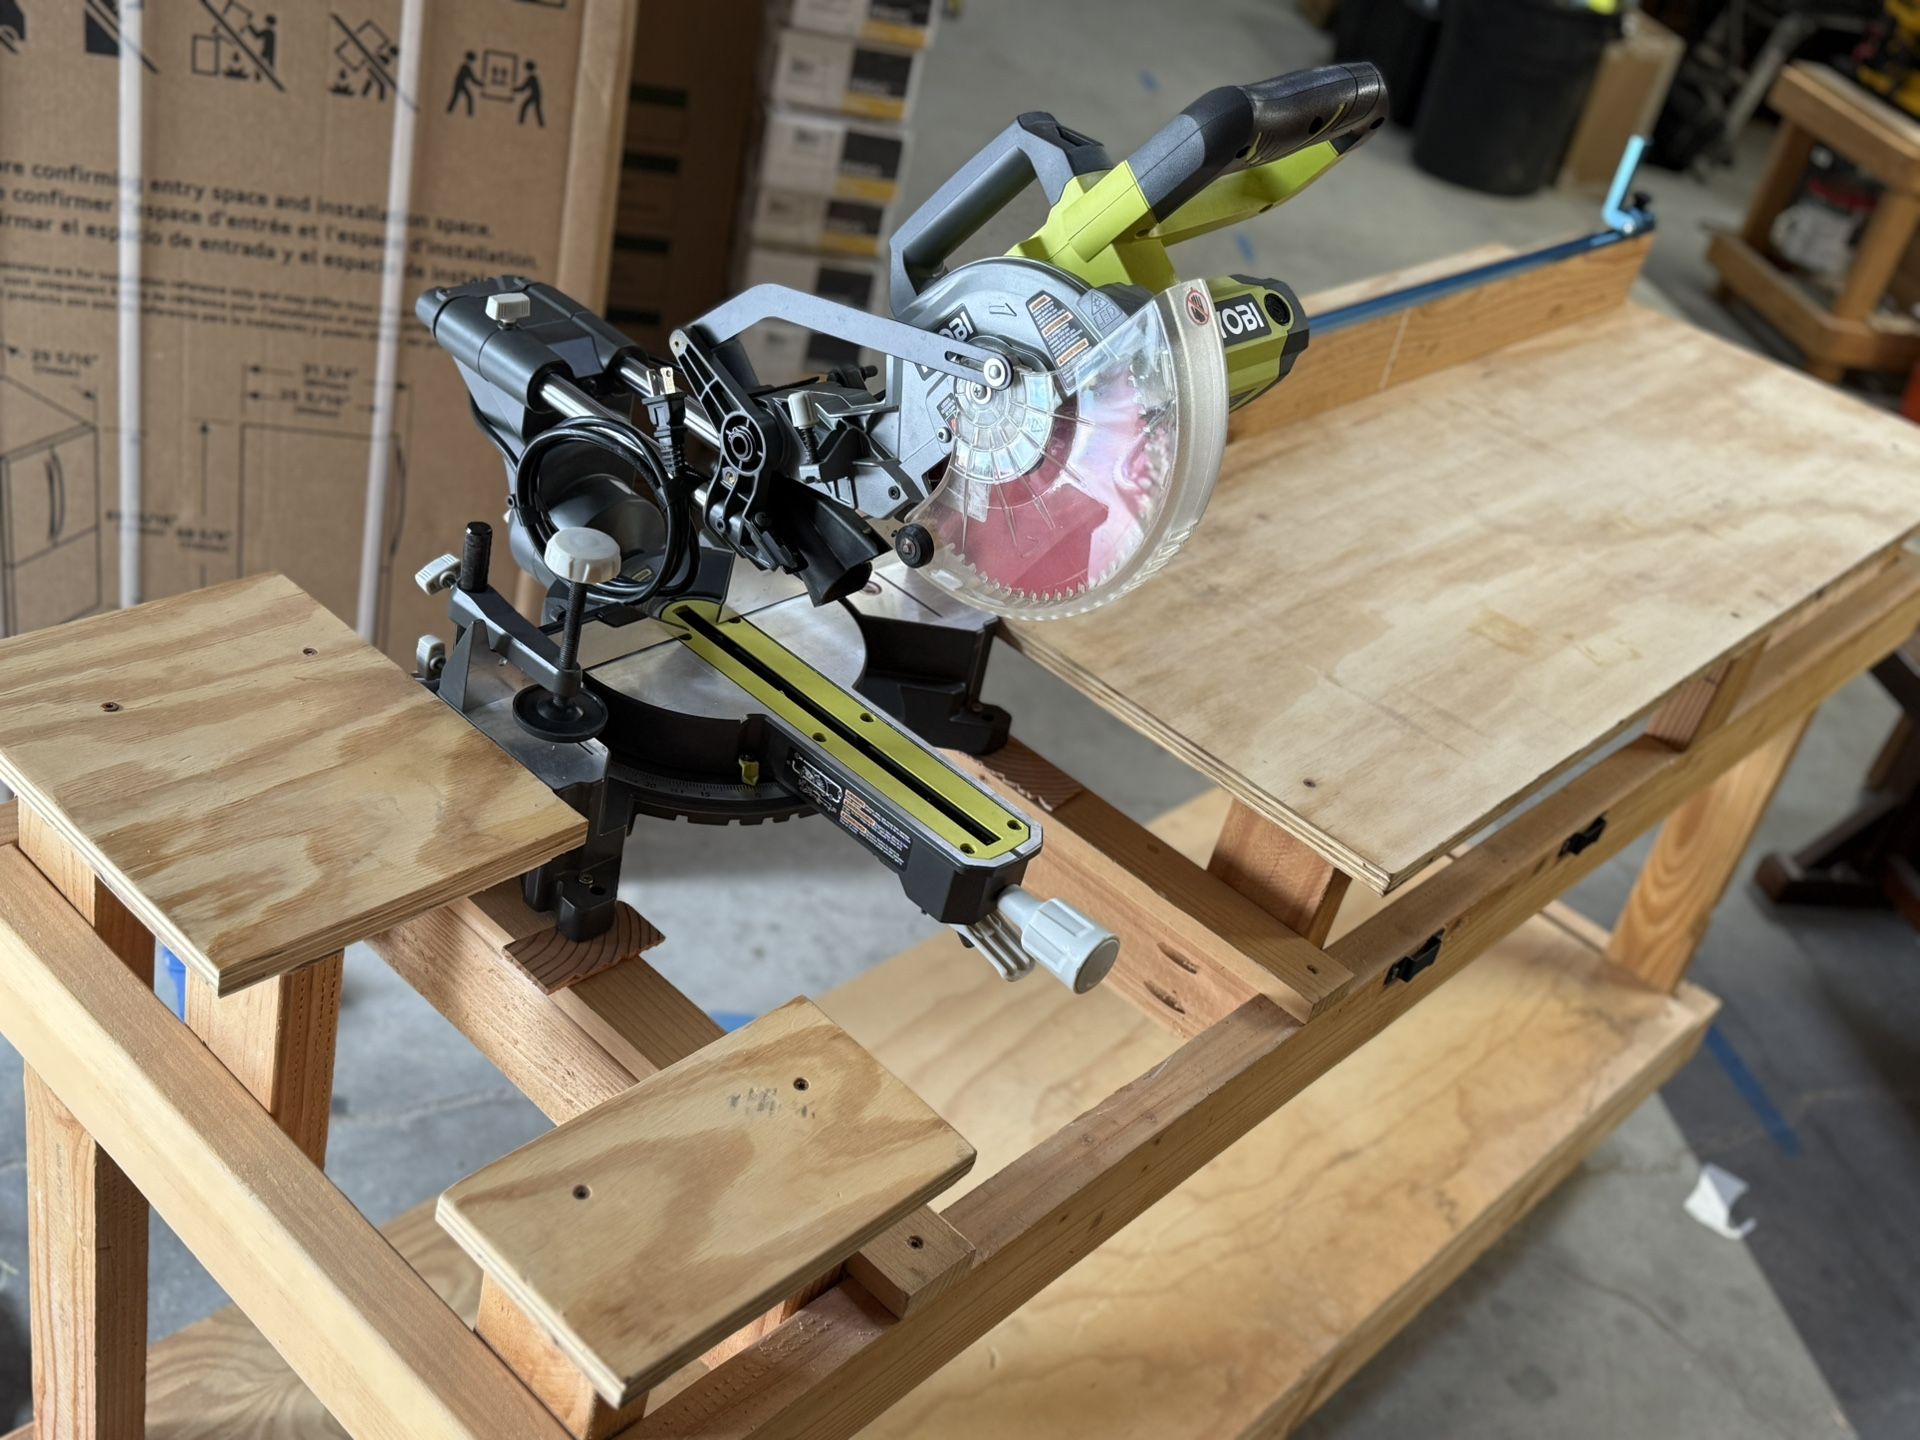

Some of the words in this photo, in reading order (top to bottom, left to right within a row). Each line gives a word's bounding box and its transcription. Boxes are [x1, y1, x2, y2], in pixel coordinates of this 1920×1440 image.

[13, 188, 112, 212] confirmer
[299, 225, 319, 241] et
[151, 179, 205, 202] entry
[211, 187, 268, 207] space
[274, 194, 311, 213] and
[61, 219, 80, 235] el
[169, 229, 193, 247] de
[200, 236, 277, 260] entrada
[283, 250, 293, 266] y
[301, 251, 318, 266] el
[406, 262, 425, 278] de
